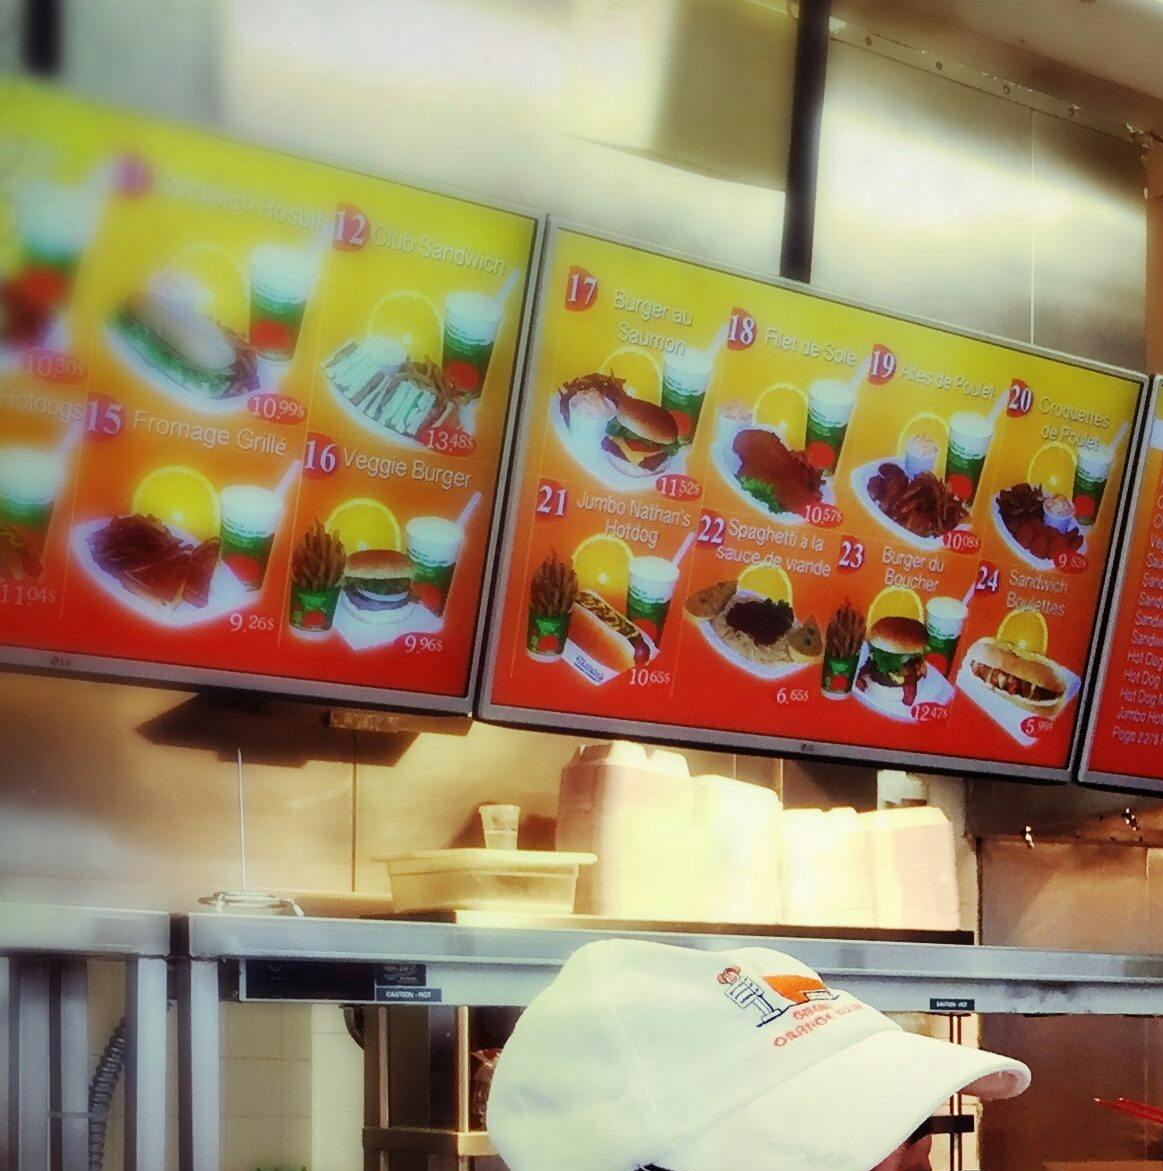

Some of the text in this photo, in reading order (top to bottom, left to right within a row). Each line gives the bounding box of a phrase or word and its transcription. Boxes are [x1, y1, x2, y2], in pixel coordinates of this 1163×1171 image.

[333, 209, 506, 275] 12 Club Sandwich
[568, 273, 598, 305] 17
[613, 289, 693, 327] Burger au
[617, 321, 687, 357] Saumon
[728, 314, 857, 369] 18 Filet de Sole
[870, 349, 996, 401] 19 Ailes de Poulet
[251, 396, 306, 420] 10.99$
[1008, 384, 1111, 431] 20 Croquettes
[86, 400, 287, 457] 15 Fromage Grillé
[426, 428, 474, 450] 13.48$
[1041, 424, 1103, 452] de Poulet
[304, 439, 472, 490] 16 Veggie Burger
[537, 484, 692, 528] 21 Jumbo Nathan's
[604, 519, 660, 550] Hotdog
[697, 514, 824, 552] 22 Spaghetti la
[765, 550, 783, 569] de
[786, 556, 832, 577] viande
[838, 540, 945, 573] 23 Burger du
[884, 567, 940, 593] Boucher
[975, 564, 1069, 593] 24 Sandwich
[1006, 591, 1065, 617] Boulettes
[228, 612, 275, 634] 9.26$
[404, 634, 443, 656] 9.96$
[1127, 649, 1163, 670] Hot Dog
